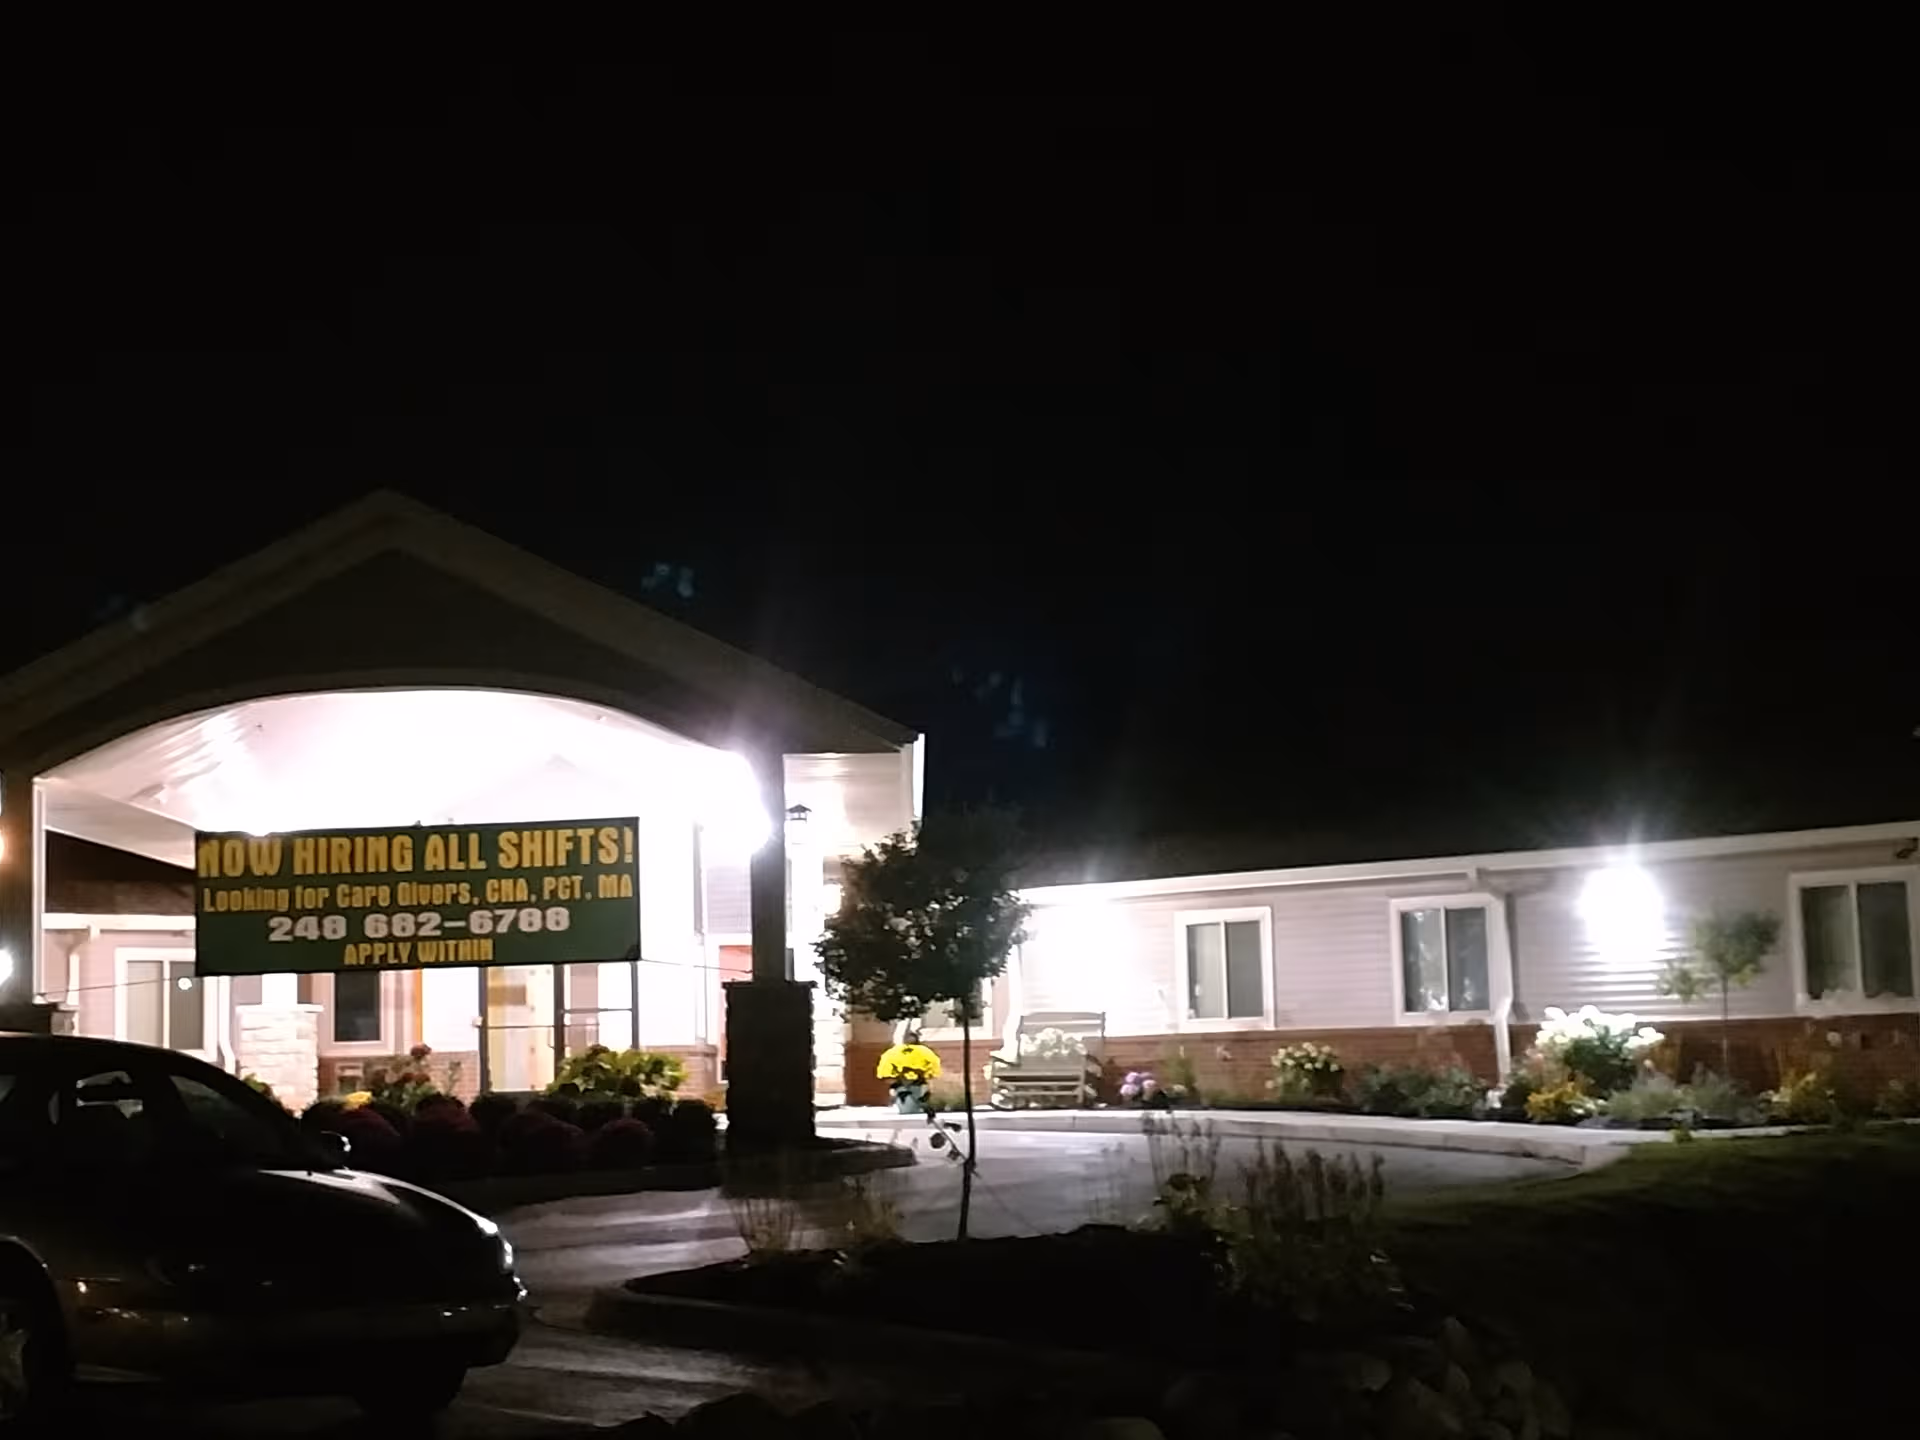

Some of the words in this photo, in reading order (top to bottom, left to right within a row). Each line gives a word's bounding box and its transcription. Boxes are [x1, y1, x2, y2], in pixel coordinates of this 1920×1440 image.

[198, 837, 282, 878] NOW
[293, 834, 413, 875] HIRING
[424, 832, 487, 871] ALL
[498, 826, 633, 869] SHIFTS!
[204, 886, 289, 912] Looking
[295, 885, 330, 910] for
[336, 883, 390, 909] Care
[598, 873, 633, 899] MA
[268, 915, 347, 942] 248
[343, 942, 411, 966] APPLY
[417, 938, 494, 962] WITHIN
